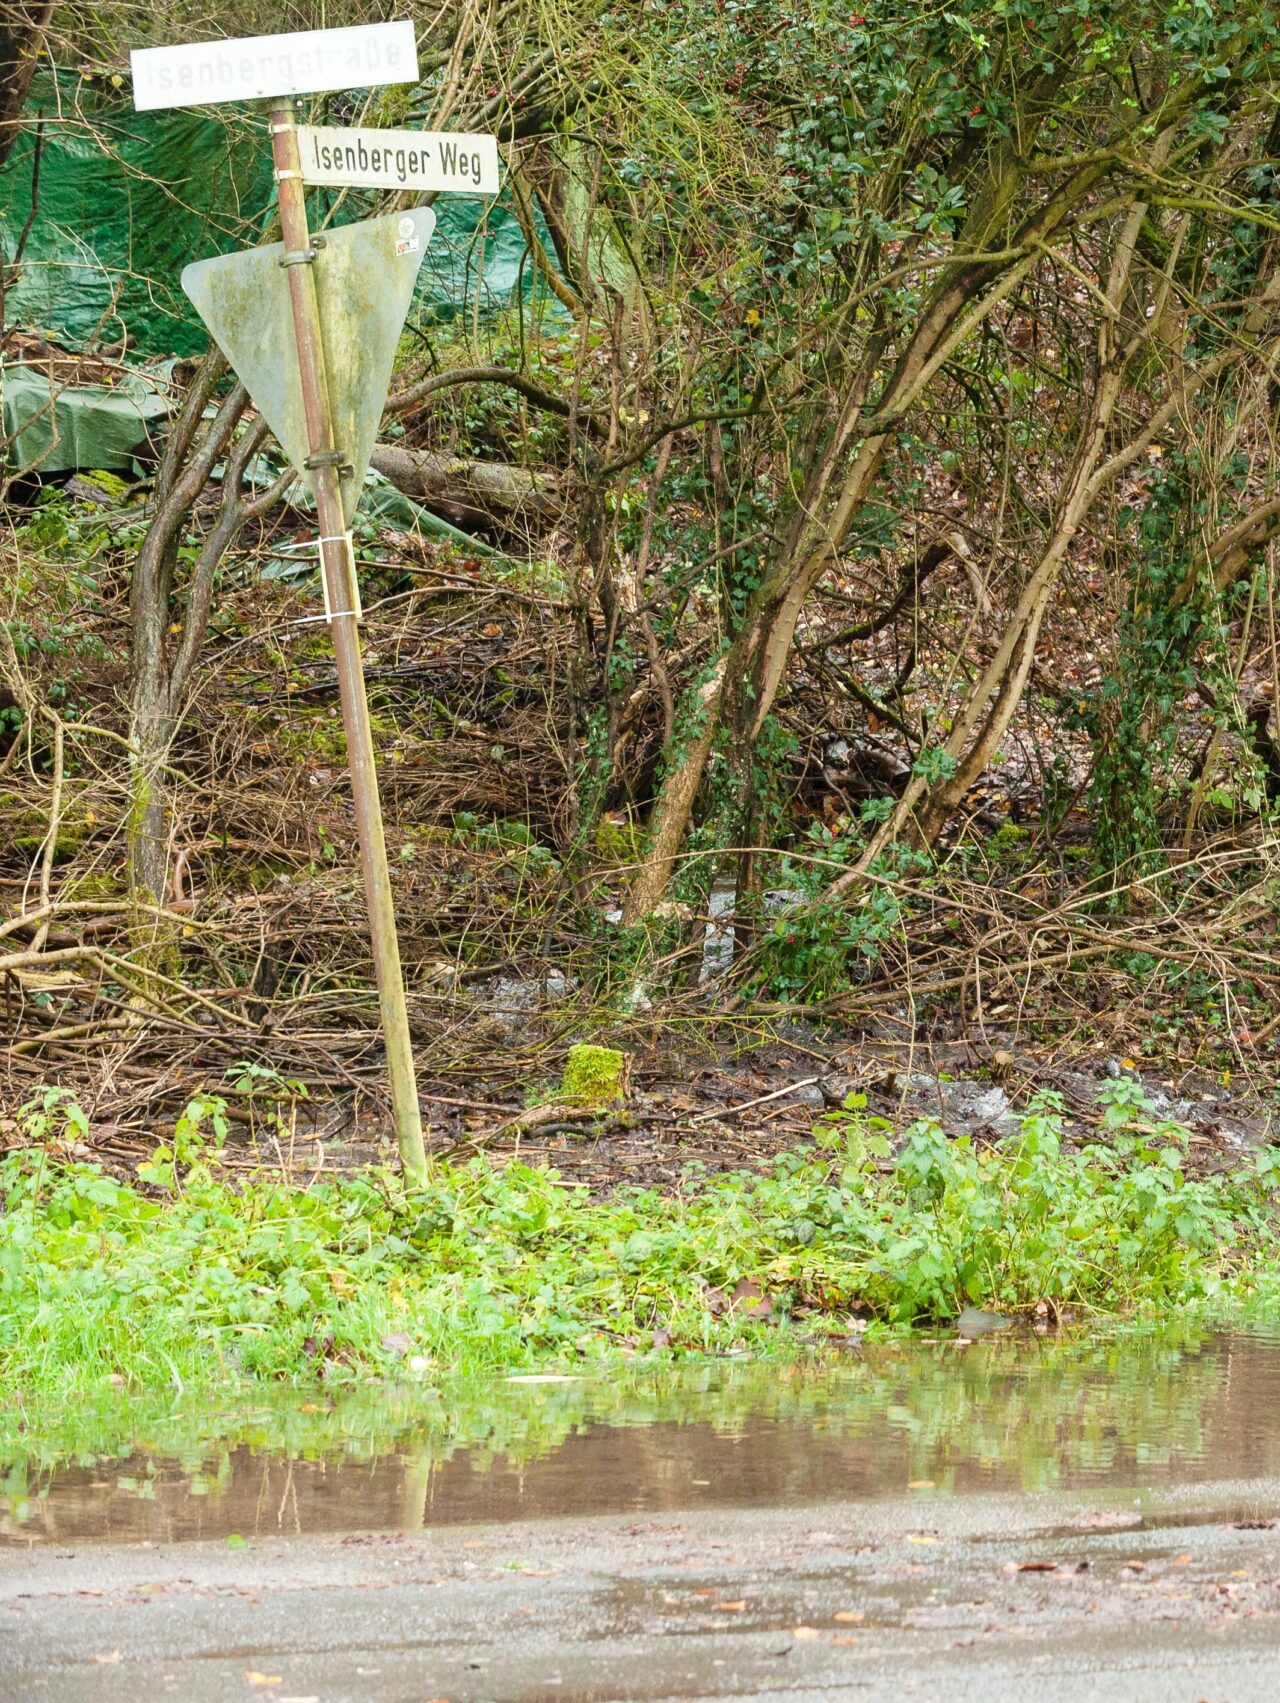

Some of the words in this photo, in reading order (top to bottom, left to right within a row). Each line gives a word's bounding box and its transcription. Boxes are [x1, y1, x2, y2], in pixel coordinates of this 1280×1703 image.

[146, 35, 402, 91] Isenbergstraße
[313, 136, 430, 182] Isenberger
[439, 142, 482, 185] Weg
